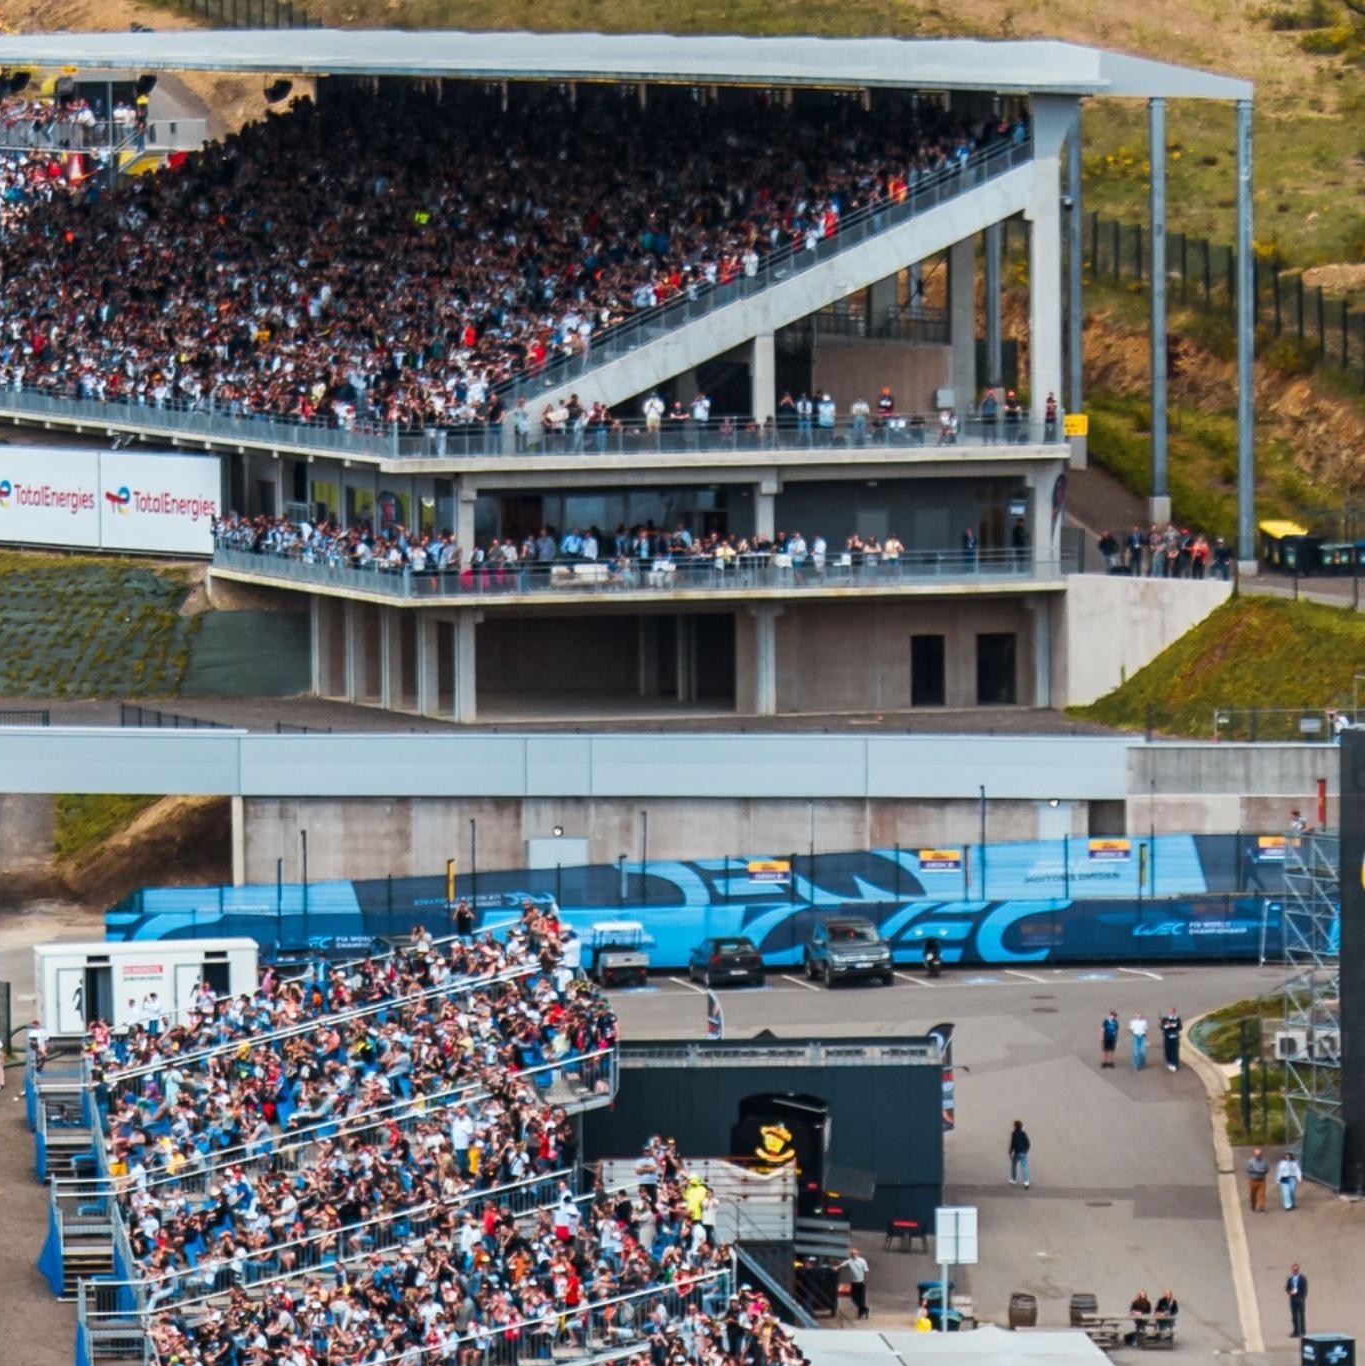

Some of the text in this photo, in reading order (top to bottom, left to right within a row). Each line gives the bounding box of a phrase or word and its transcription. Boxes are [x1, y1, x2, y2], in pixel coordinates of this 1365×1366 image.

[13, 484, 96, 515] TotalEnergies
[132, 490, 217, 522] TotalEnergies
[1132, 920, 1185, 936] WEC
